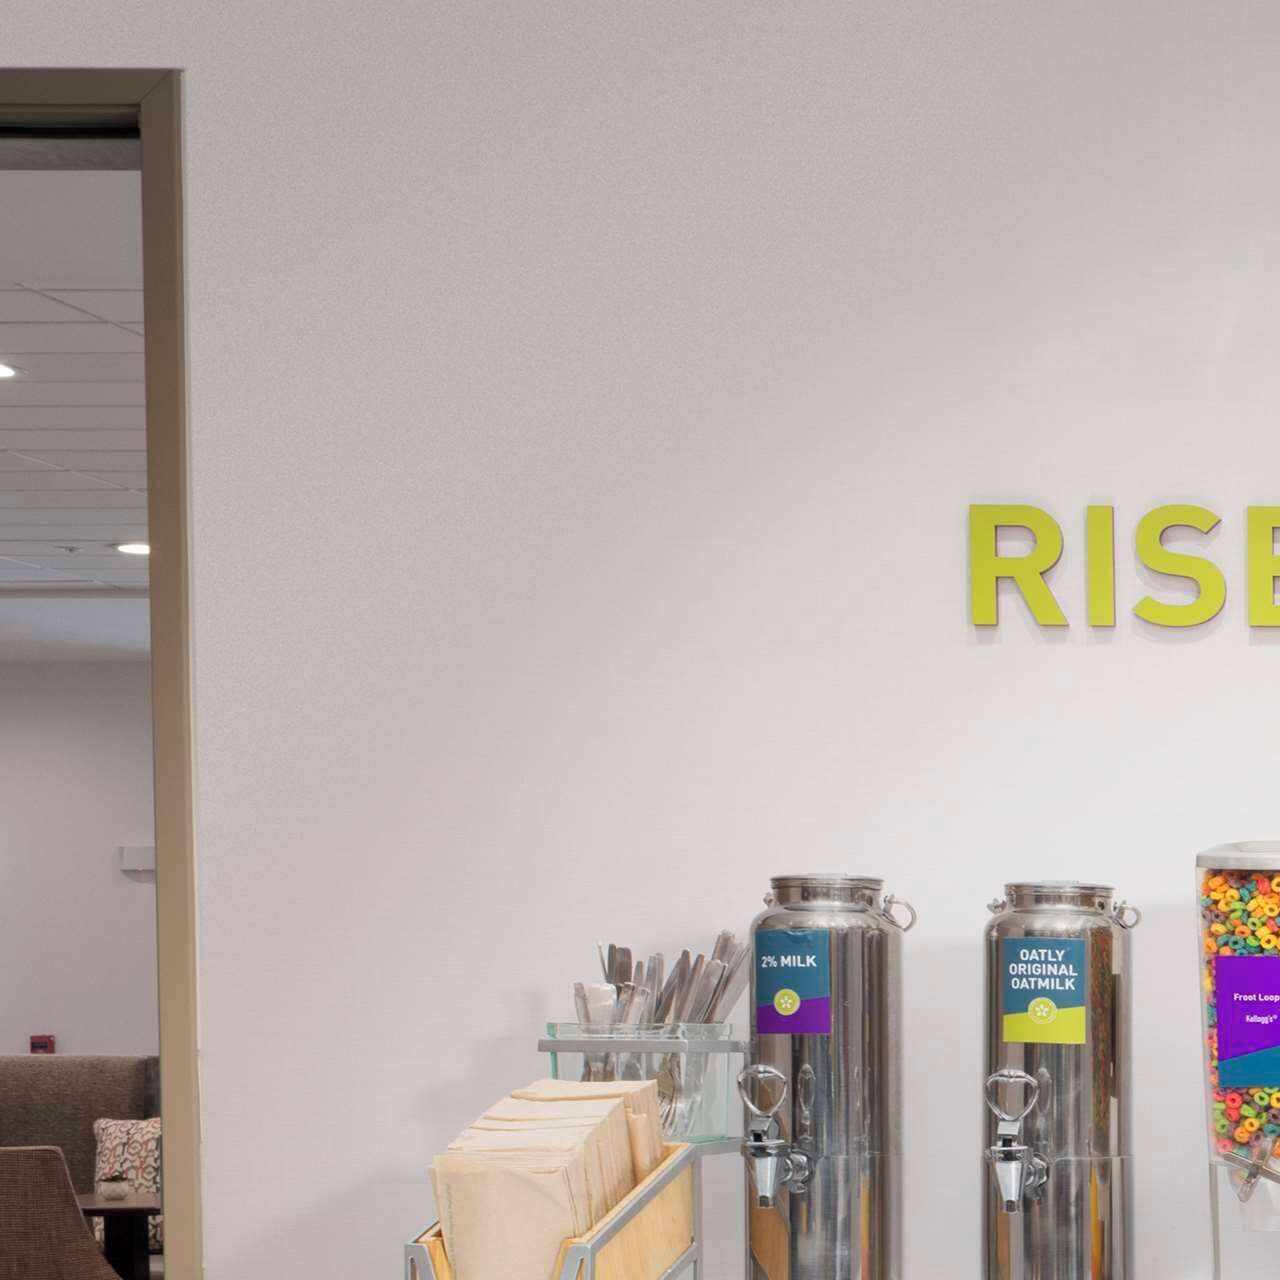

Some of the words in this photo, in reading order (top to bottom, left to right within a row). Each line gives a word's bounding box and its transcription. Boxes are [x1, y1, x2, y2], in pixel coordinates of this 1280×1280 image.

[761, 955, 777, 968] 2%
[780, 955, 817, 968] MILK
[1019, 949, 1065, 962] OATLY
[1009, 963, 1078, 976] ORIGINAL
[1011, 978, 1075, 990] OATMILK
[1234, 993, 1256, 1002] Froot
